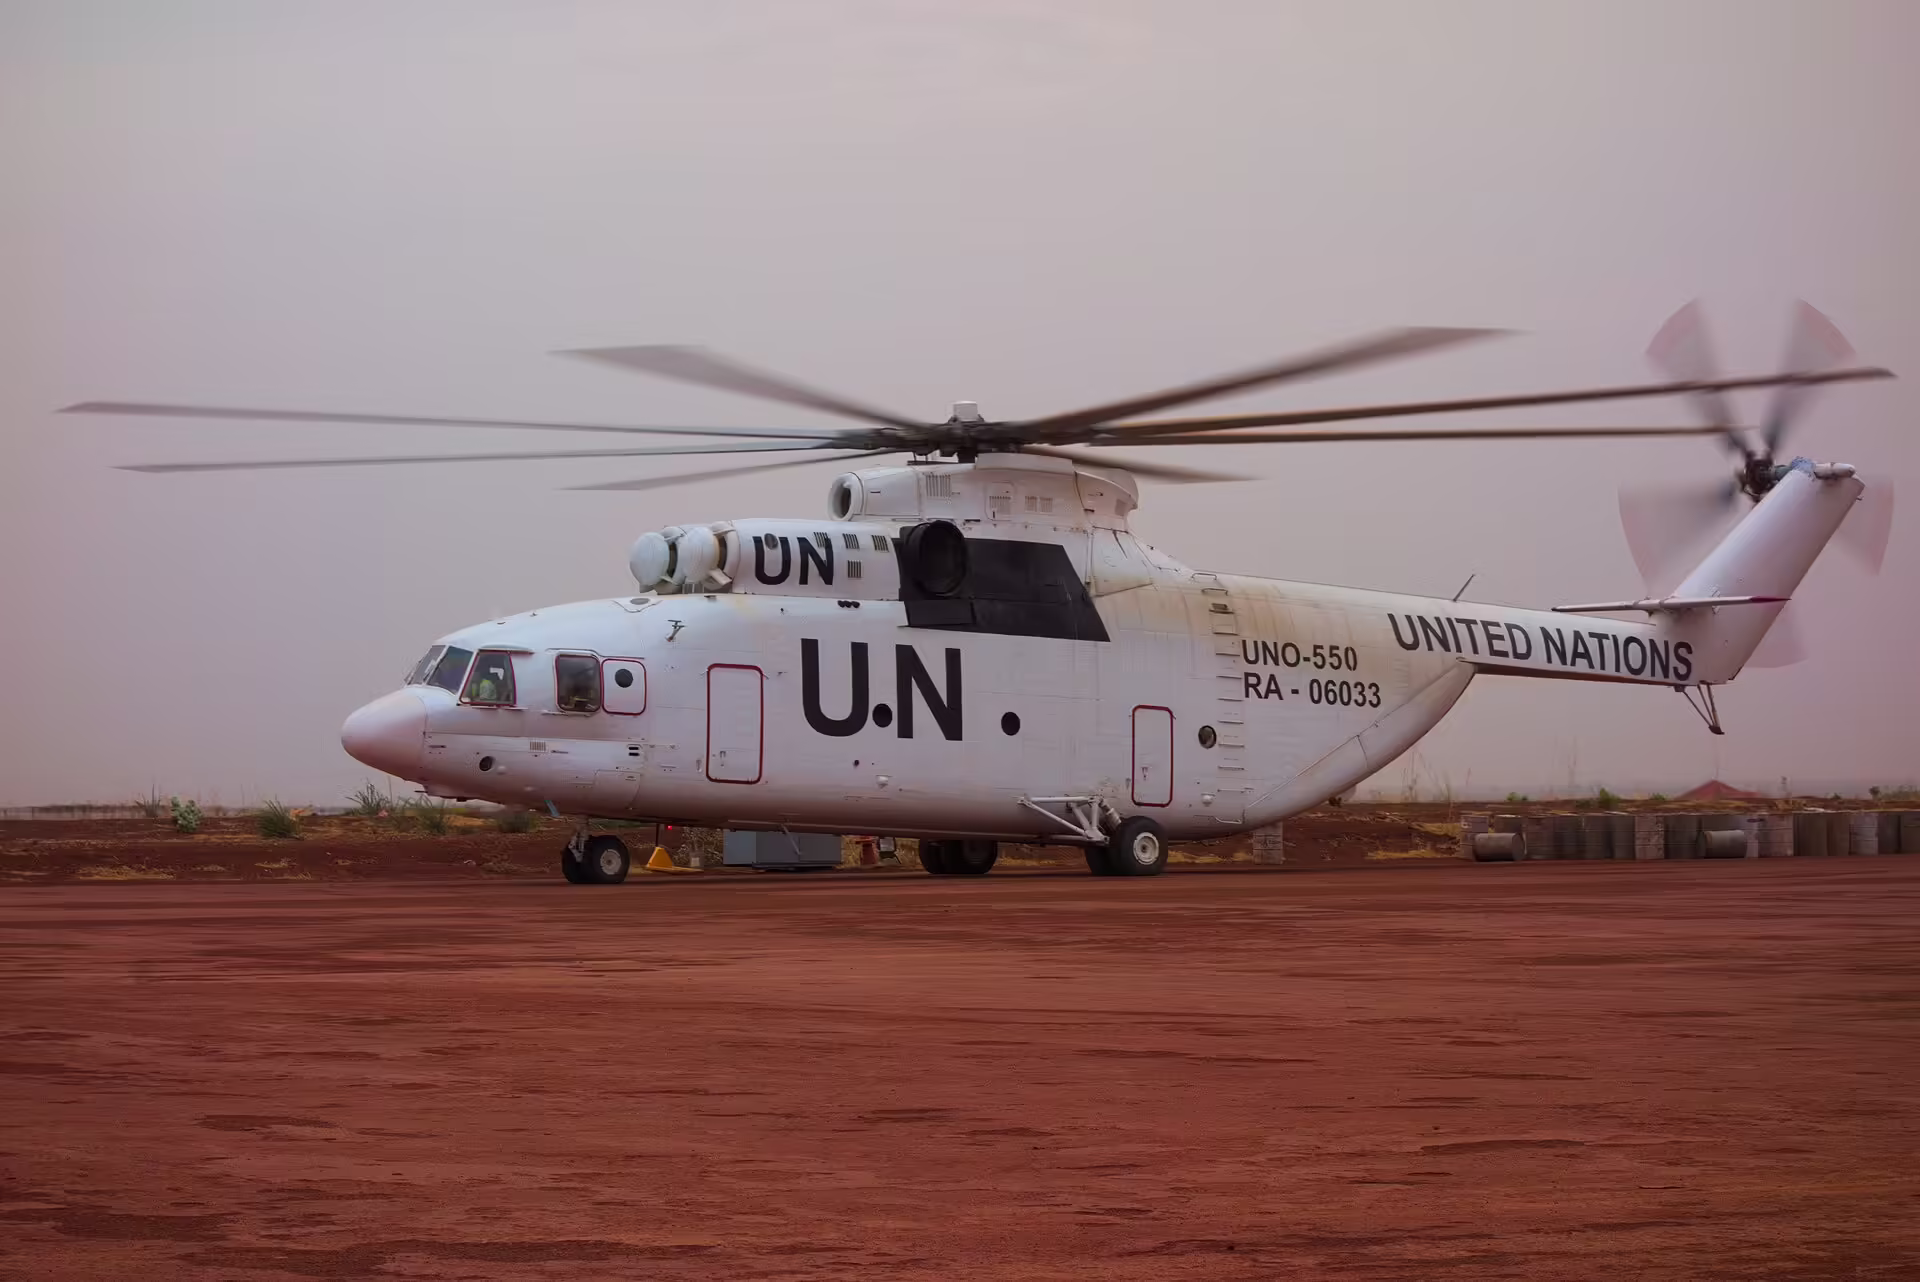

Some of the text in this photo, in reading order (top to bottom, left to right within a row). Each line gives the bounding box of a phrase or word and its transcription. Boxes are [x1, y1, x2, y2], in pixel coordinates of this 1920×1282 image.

[752, 535, 834, 586] UN
[1242, 639, 1358, 672] UNO-550
[1387, 613, 1693, 682] UNITED NATIONS
[1243, 671, 1284, 701] RA
[1309, 678, 1382, 709] 06033
